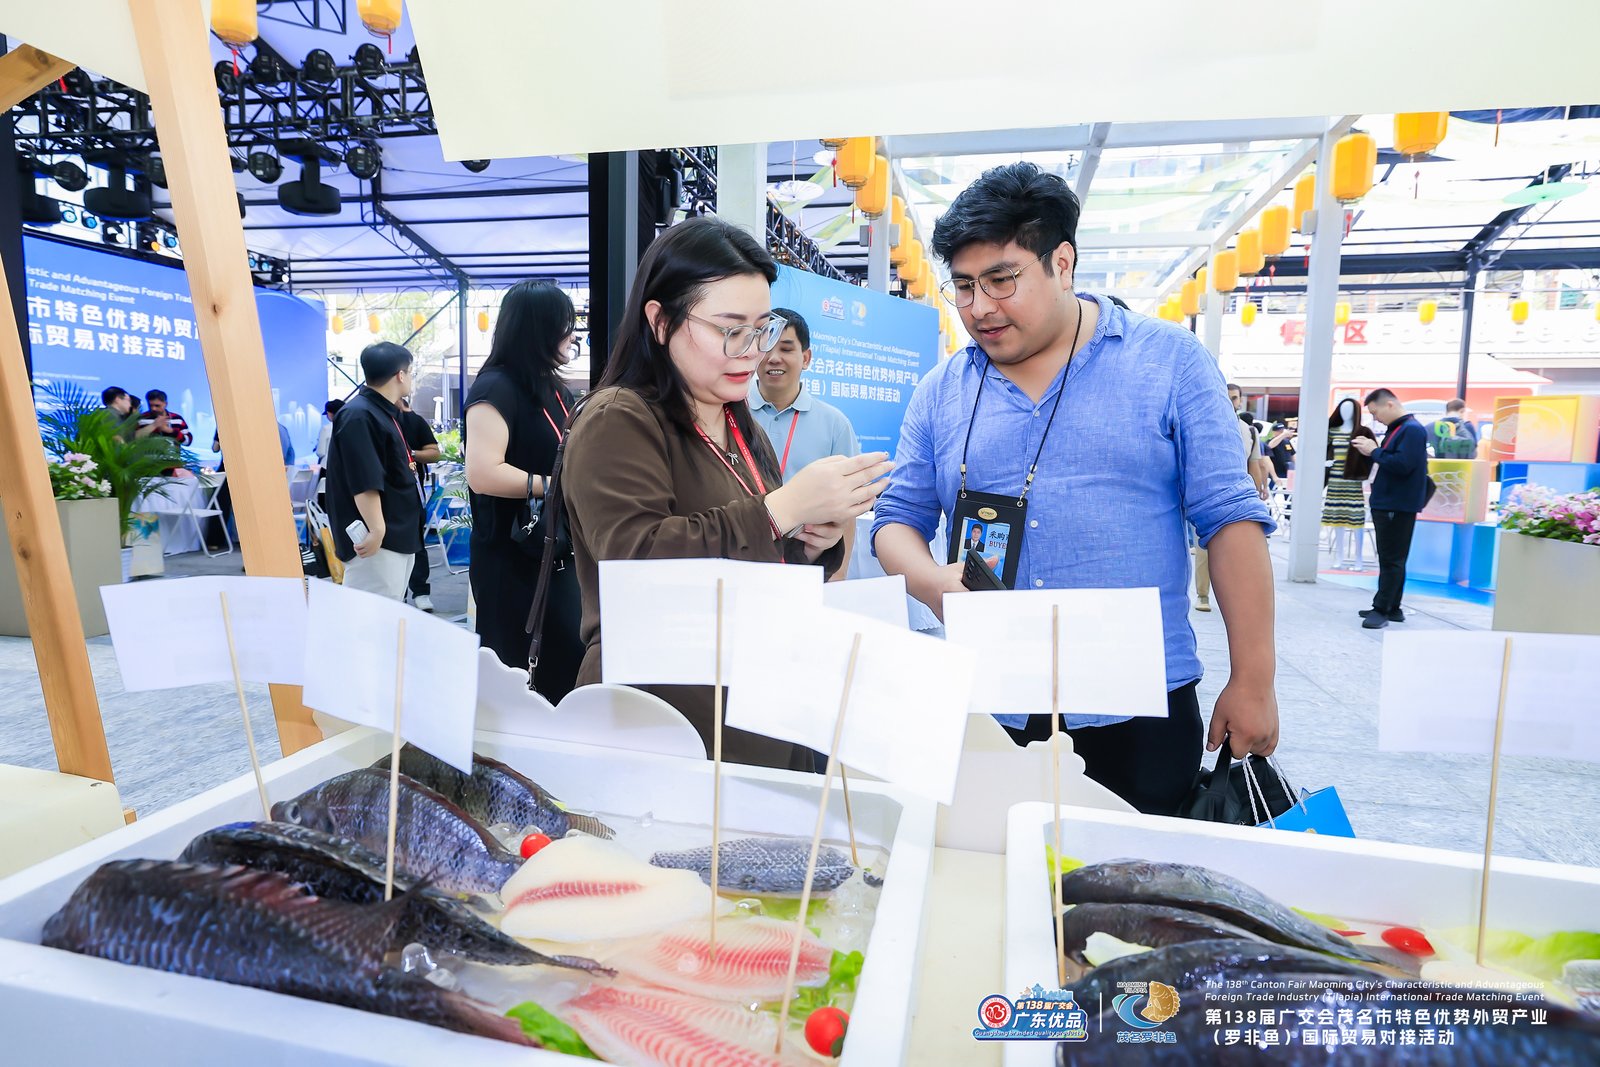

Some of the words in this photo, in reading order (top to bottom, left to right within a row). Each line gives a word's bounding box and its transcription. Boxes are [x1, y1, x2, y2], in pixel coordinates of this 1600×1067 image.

[28, 278, 59, 292] Trade
[60, 284, 107, 301] Matching
[108, 292, 135, 304] Event
[51, 271, 71, 282] and
[72, 274, 140, 293] Advantageous
[141, 287, 173, 301] Foreign
[174, 293, 193, 304] Trad
[989, 530, 1009, 541] 采购
[989, 541, 1007, 549] BUYE
